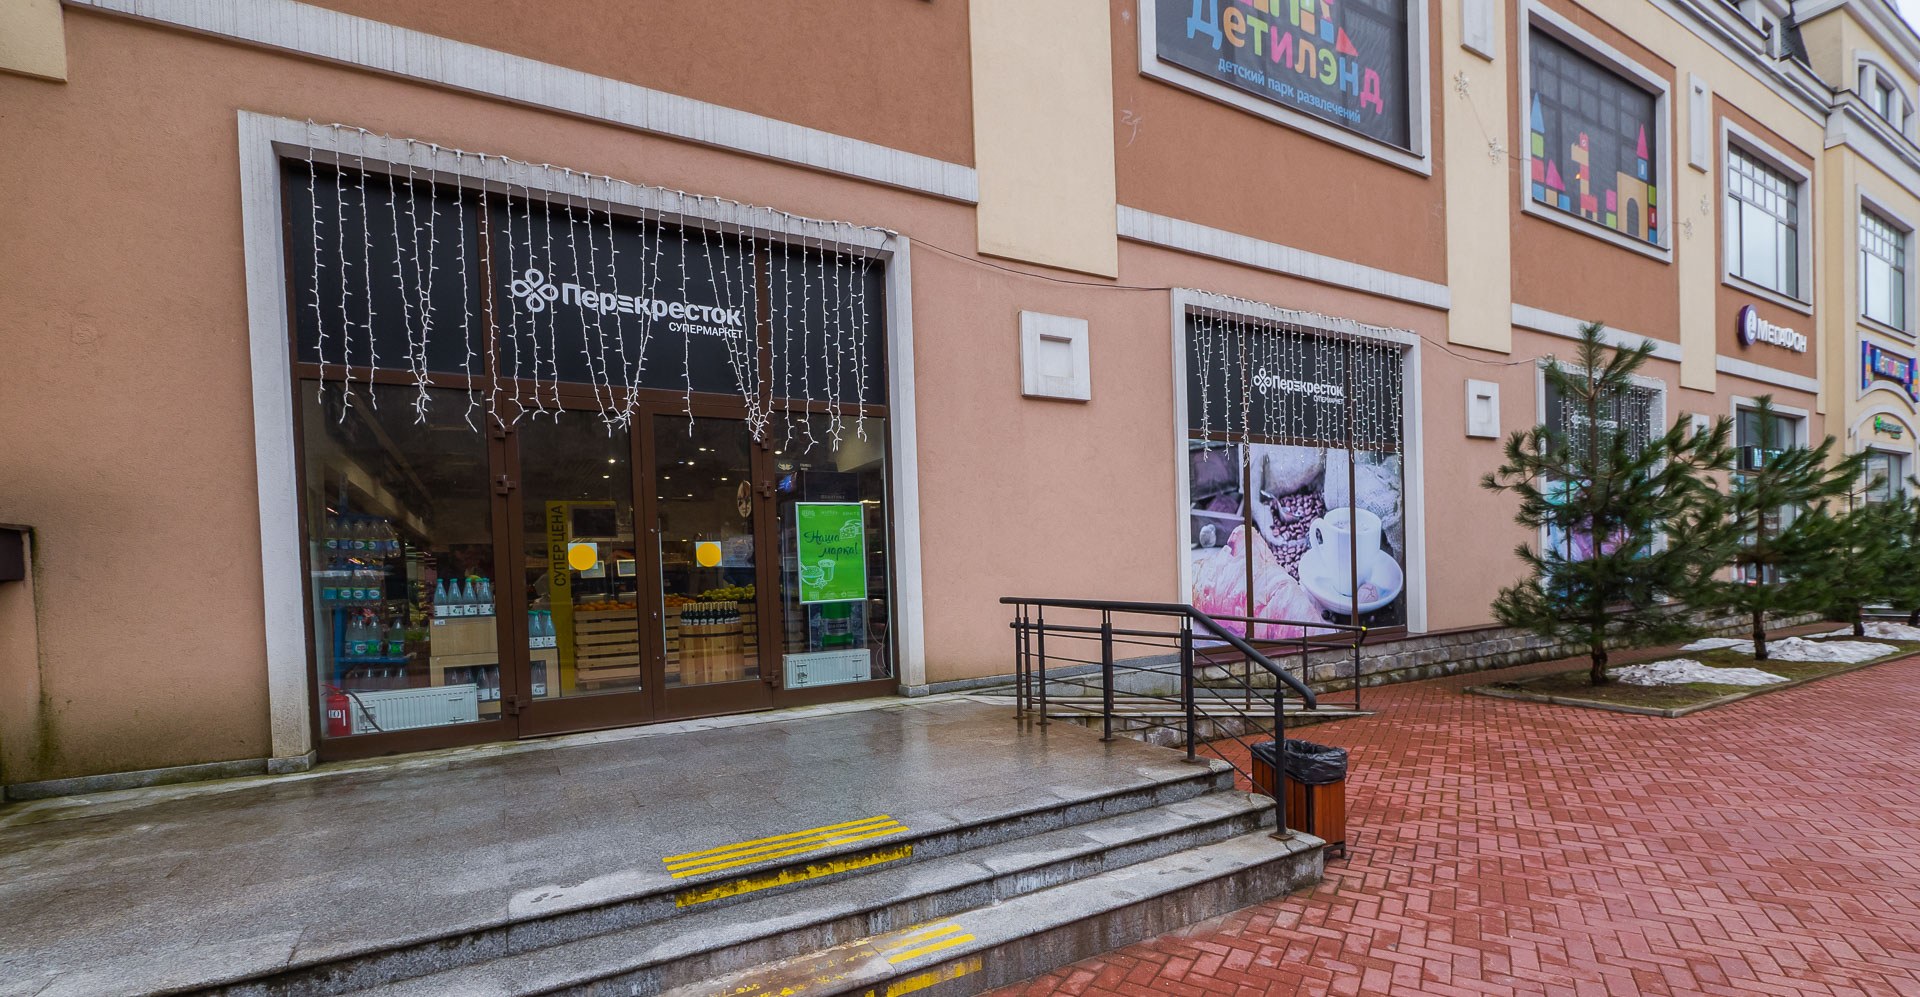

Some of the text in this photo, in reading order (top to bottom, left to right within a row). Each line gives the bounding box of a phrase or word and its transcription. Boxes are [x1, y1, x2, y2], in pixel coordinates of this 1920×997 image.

[1187, 0, 1383, 114] Детилэнд
[1218, 58, 1361, 123] детский парк развлечений
[562, 282, 743, 327] Перекресток
[669, 322, 743, 339] СУПЕРМАРКЕТ
[1272, 375, 1344, 397] Перекресток
[550, 504, 567, 587] СУПЕР ЦЕНА
[804, 530, 840, 544] Наша
[818, 542, 858, 561] марка!
